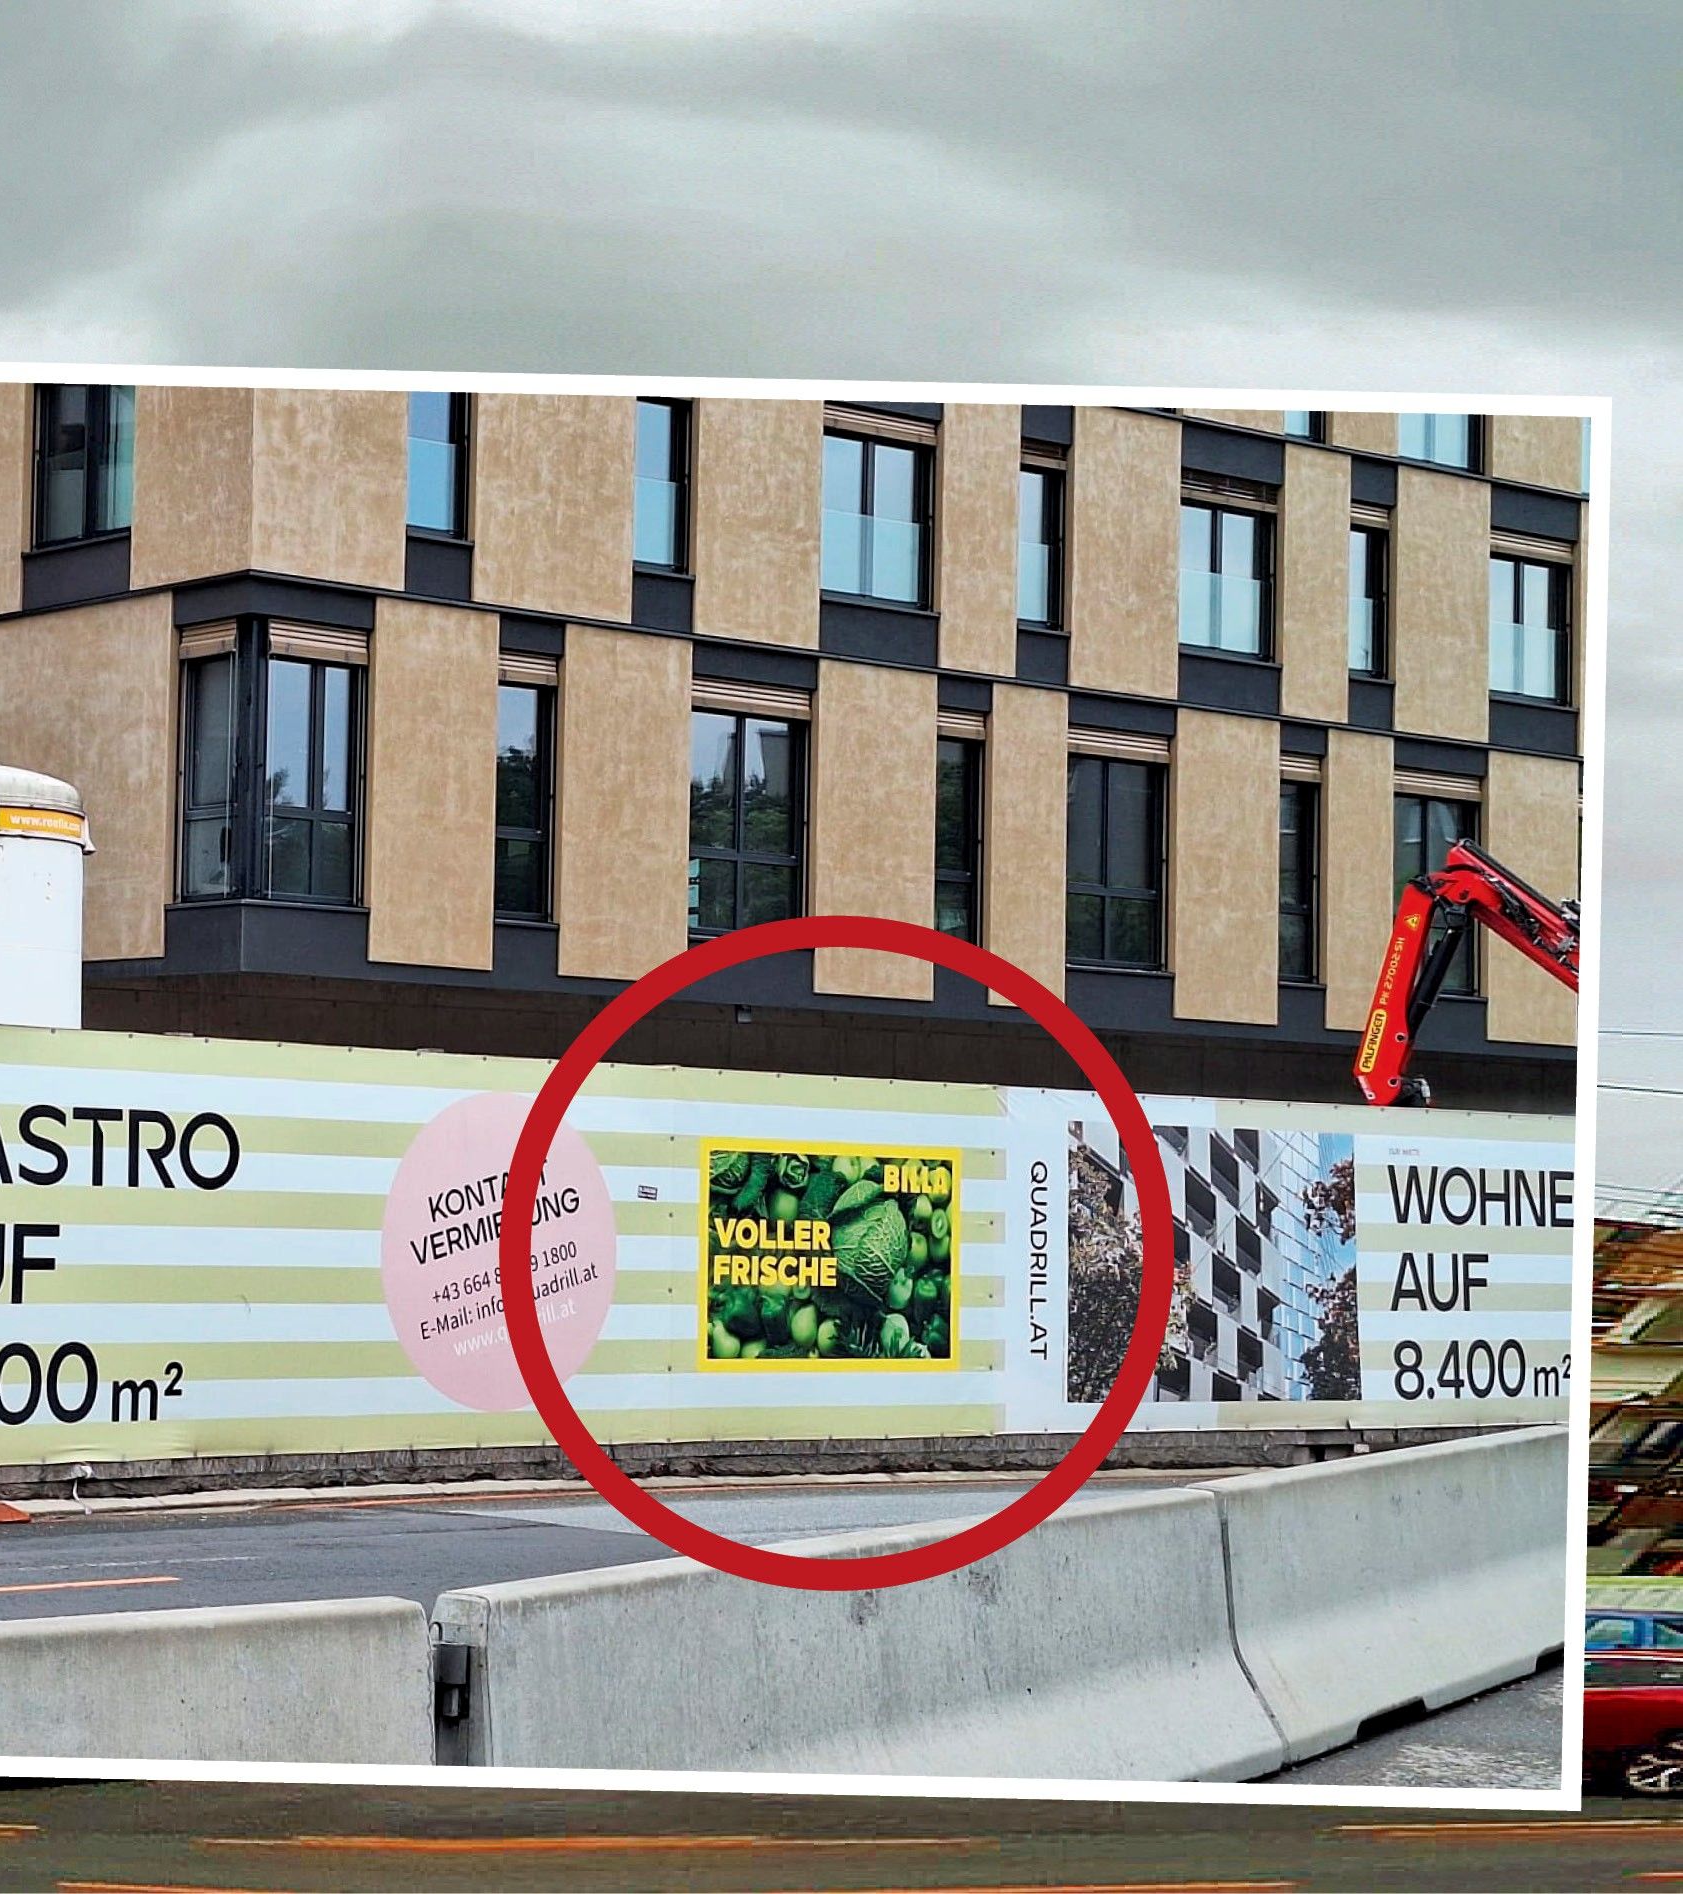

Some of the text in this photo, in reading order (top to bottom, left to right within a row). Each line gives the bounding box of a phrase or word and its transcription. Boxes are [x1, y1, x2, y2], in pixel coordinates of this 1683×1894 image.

[428, 1159, 548, 1222] KONTAT
[883, 1164, 949, 1195] BILLA
[410, 1187, 581, 1266] VERMIEUNG
[714, 1217, 832, 1251] VOLLER
[432, 1282, 460, 1303] +43
[463, 1270, 491, 1296] 664
[542, 1240, 577, 1268] 1800
[713, 1255, 838, 1287] FRISCHE
[1029, 1160, 1049, 1361] QUADRILL.AT
[1390, 1252, 1490, 1312] AUF
[420, 1261, 599, 1340] E-Mail: infouadrill.at
[1393, 1338, 1527, 1401] 8.400
